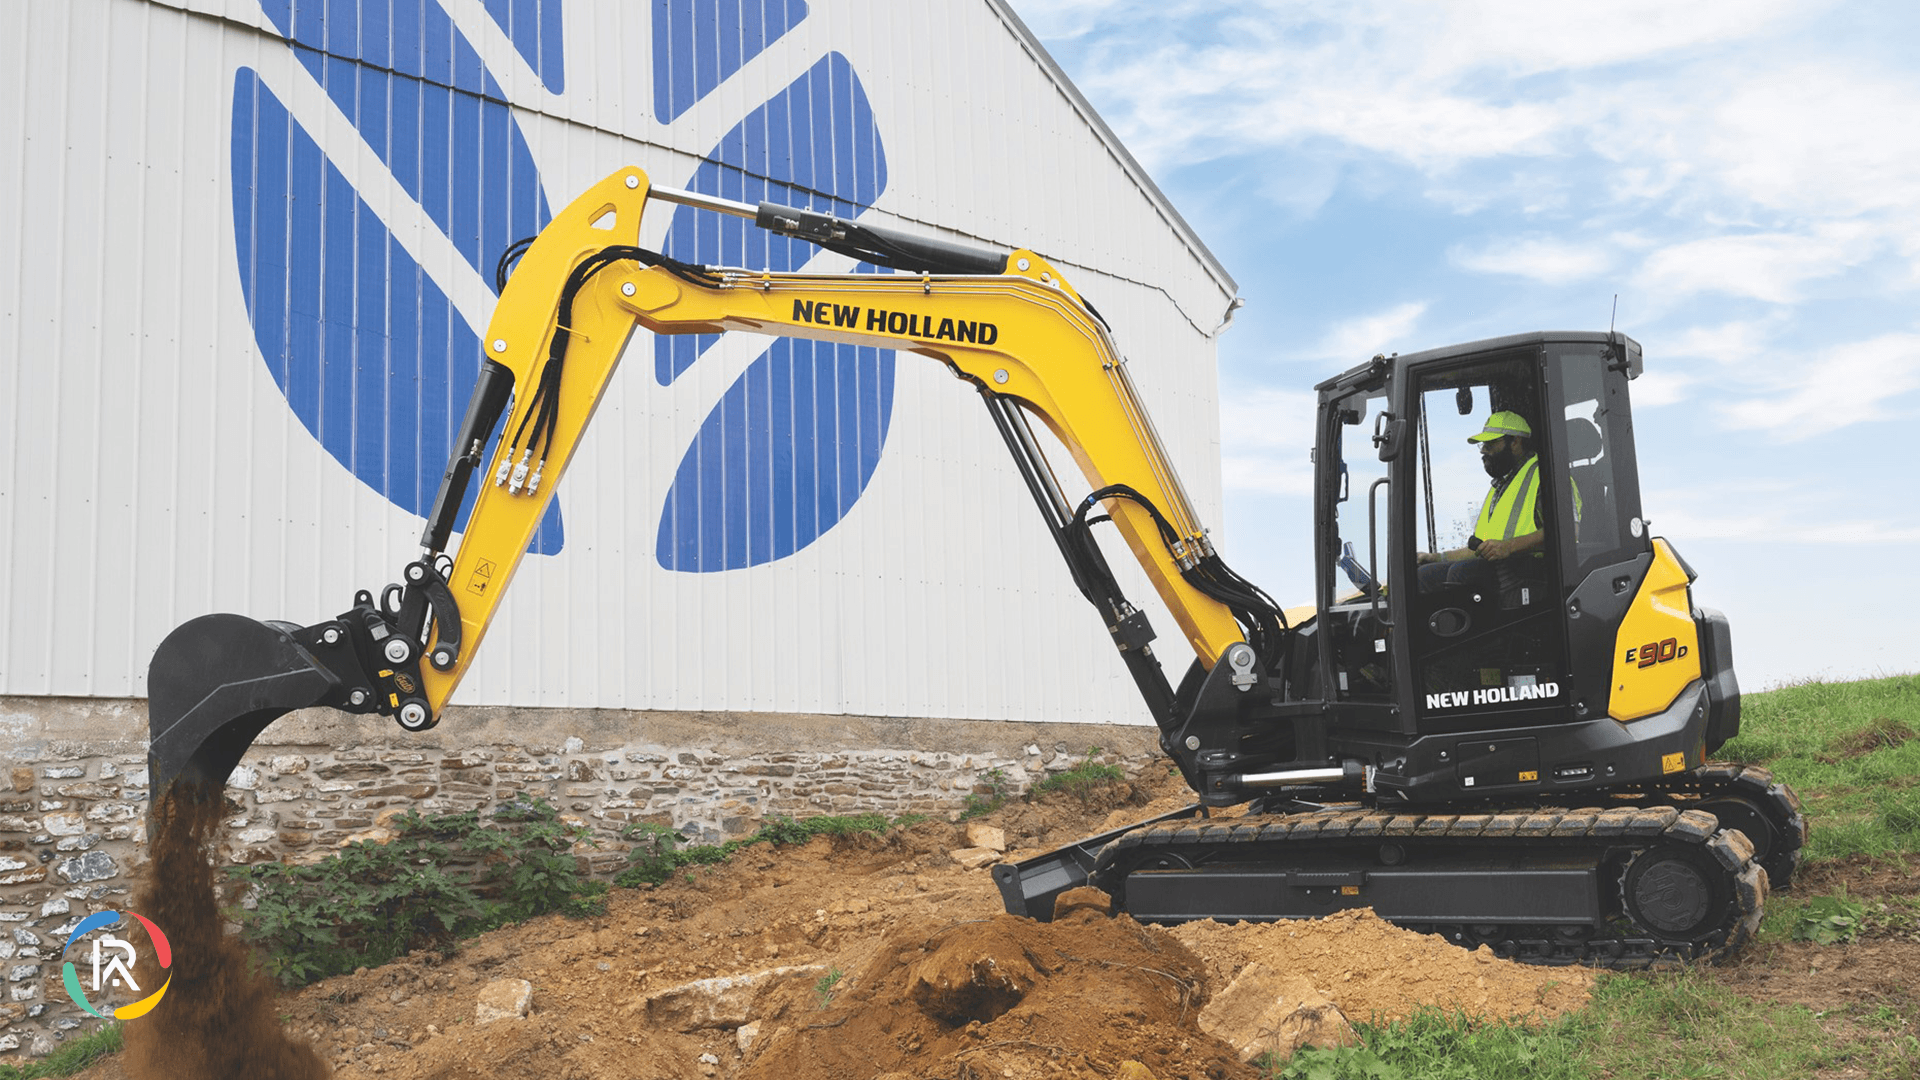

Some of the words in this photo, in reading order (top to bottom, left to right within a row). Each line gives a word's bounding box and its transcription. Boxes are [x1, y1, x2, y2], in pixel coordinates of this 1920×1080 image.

[792, 299, 861, 328] NEW
[866, 308, 998, 345] HOLLAND
[1426, 691, 1469, 709] NEW
[1473, 682, 1559, 705] HOLLAND
